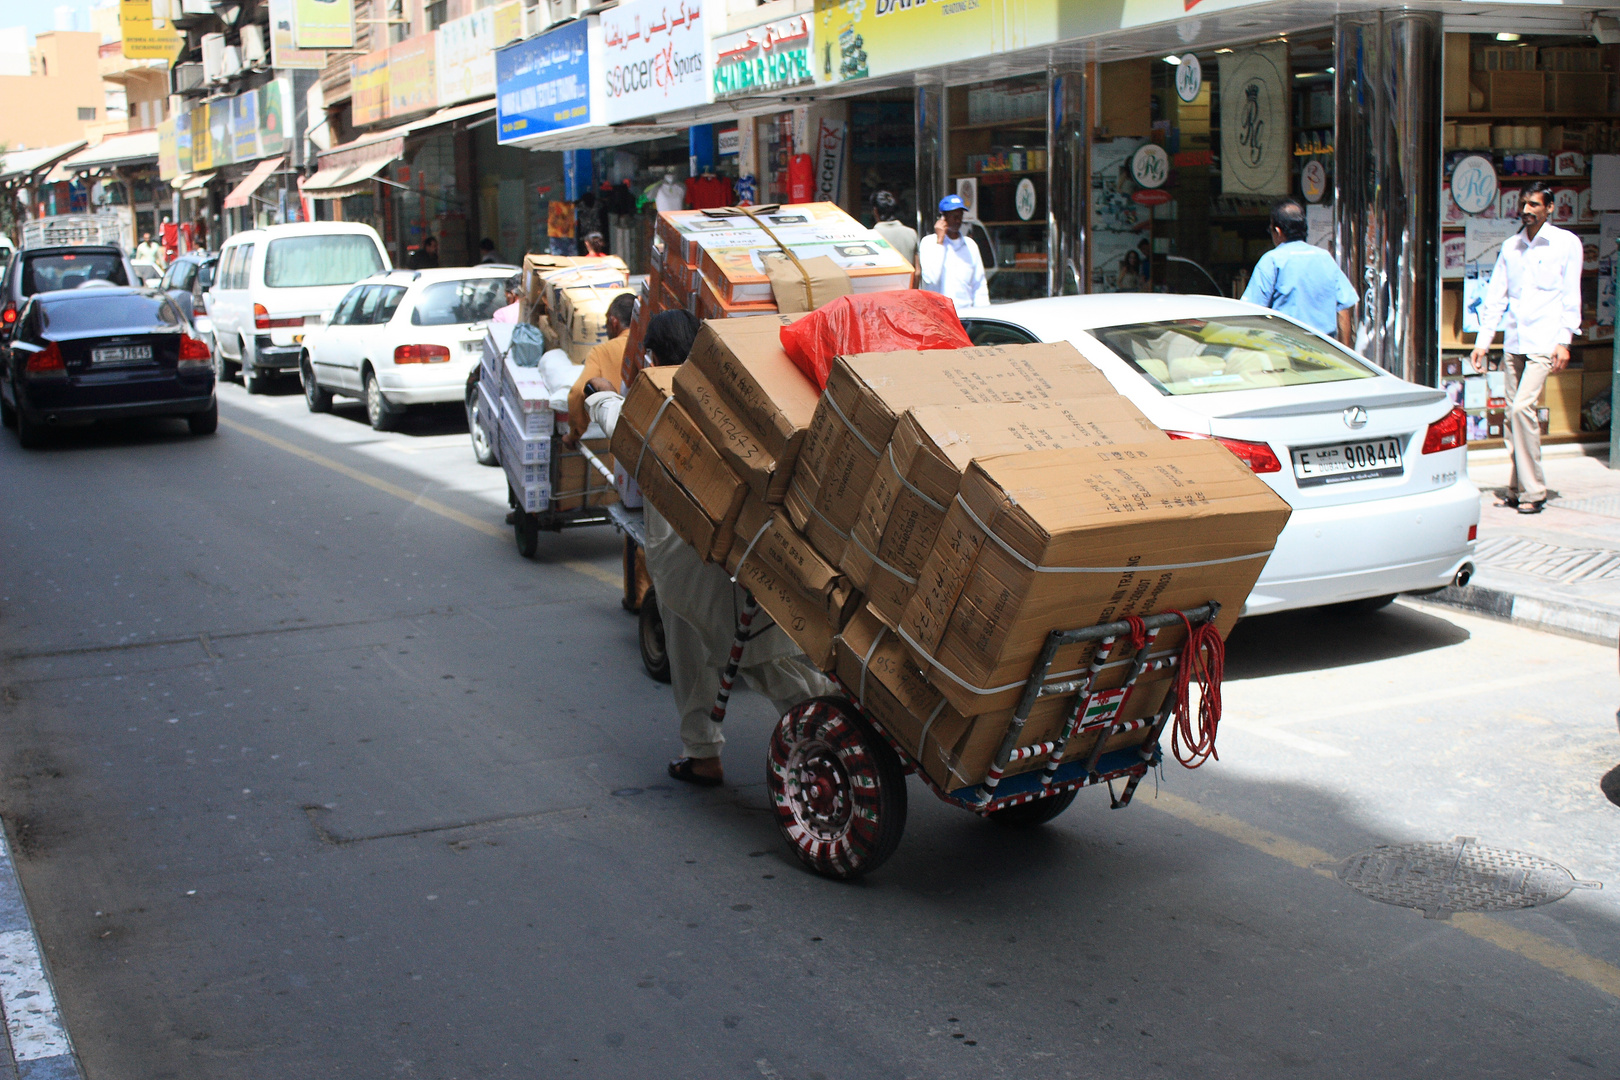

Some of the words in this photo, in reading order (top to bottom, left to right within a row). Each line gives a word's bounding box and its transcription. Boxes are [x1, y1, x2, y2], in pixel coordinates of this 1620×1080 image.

[762, 15, 808, 52] فندق
[673, 51, 702, 83] Sports
[768, 48, 812, 82] HOTEL
[1456, 167, 1494, 208] RG
[1301, 453, 1312, 474] E
[1345, 442, 1398, 469] 90844
